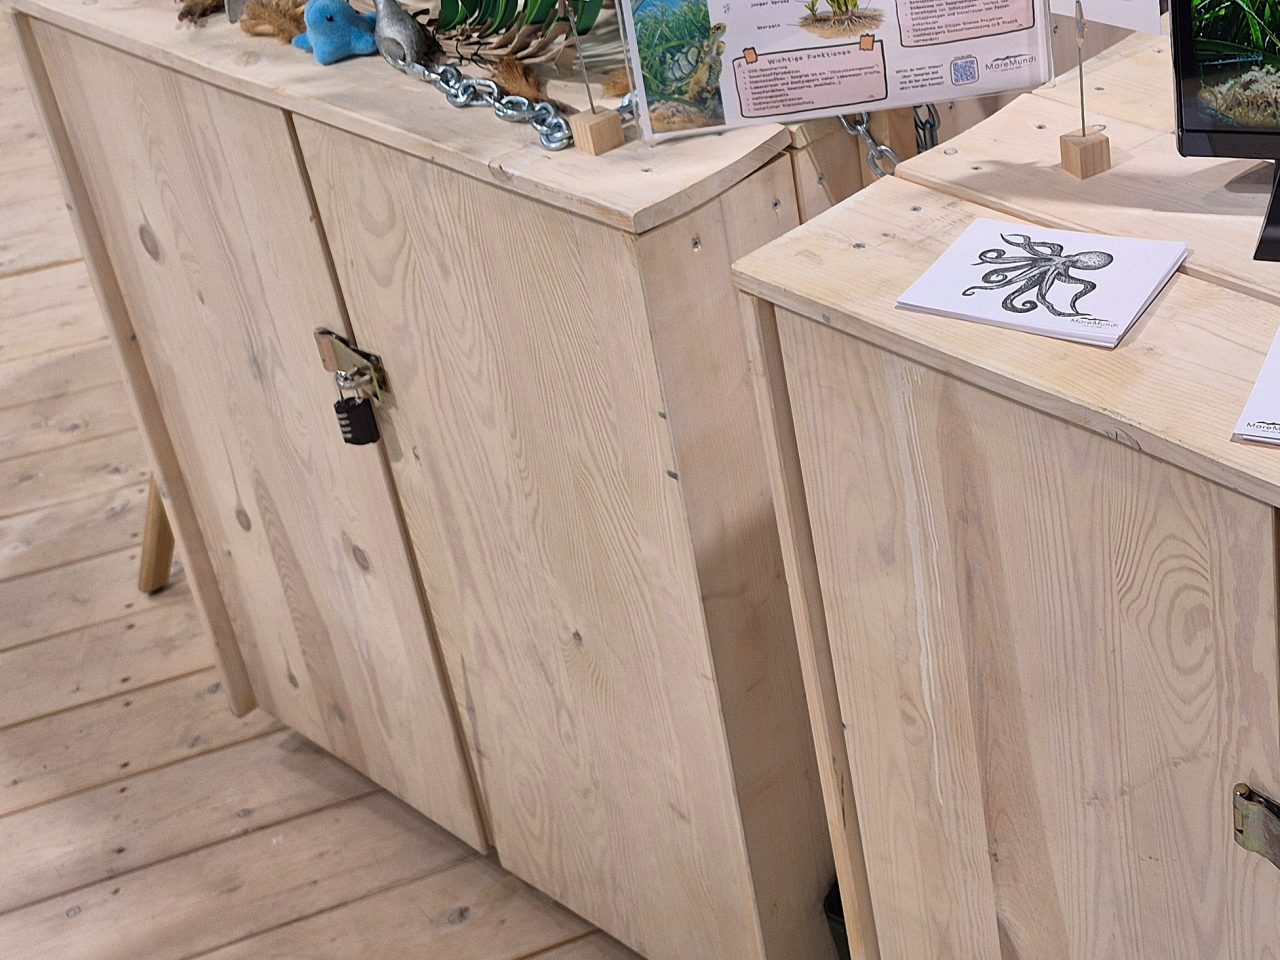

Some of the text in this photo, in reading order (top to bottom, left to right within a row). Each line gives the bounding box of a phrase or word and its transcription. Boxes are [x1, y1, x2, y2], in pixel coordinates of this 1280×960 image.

[767, 49, 852, 65] Wichtige Funktionen
[985, 56, 1037, 71] MareMundi
[1070, 318, 1119, 329] MareMundi
